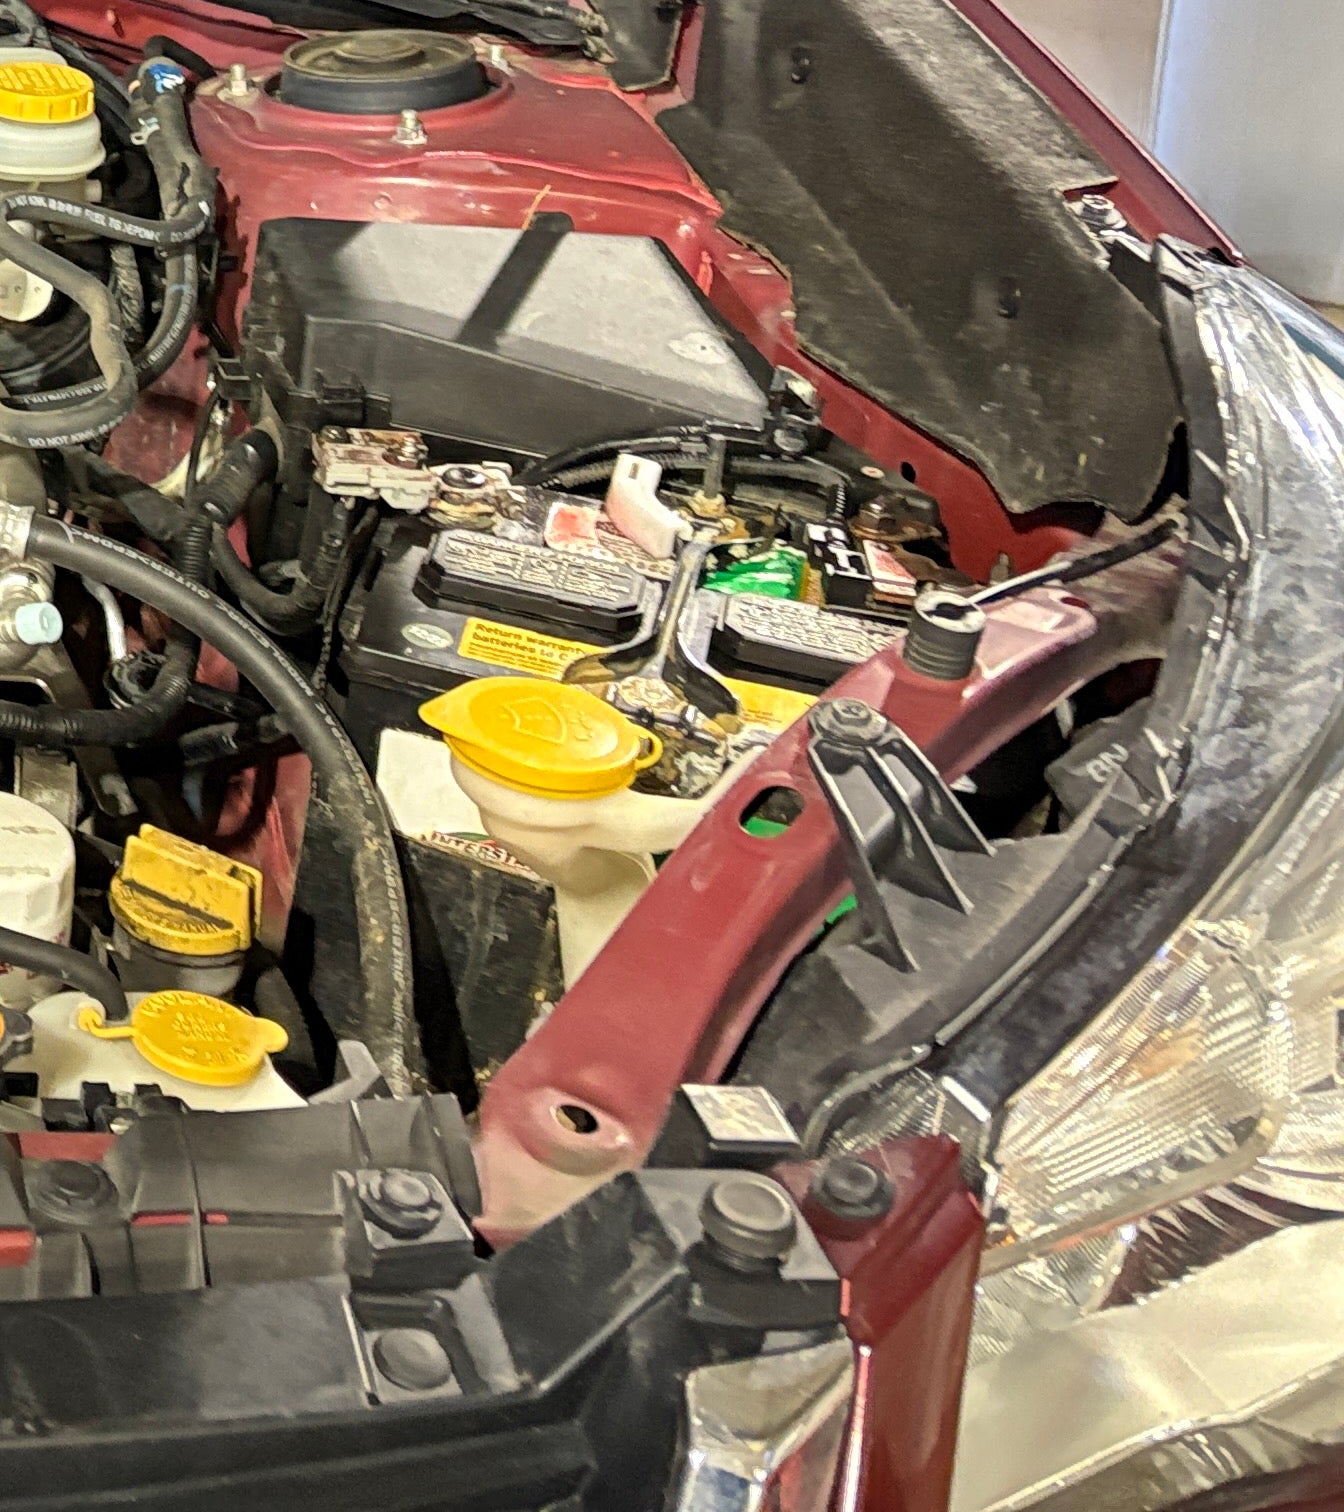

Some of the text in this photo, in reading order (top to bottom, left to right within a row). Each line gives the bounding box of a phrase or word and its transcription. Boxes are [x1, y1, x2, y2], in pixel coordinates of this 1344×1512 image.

[472, 632, 537, 653] batteries
[475, 623, 513, 640] Return
[526, 636, 586, 655] warrant
